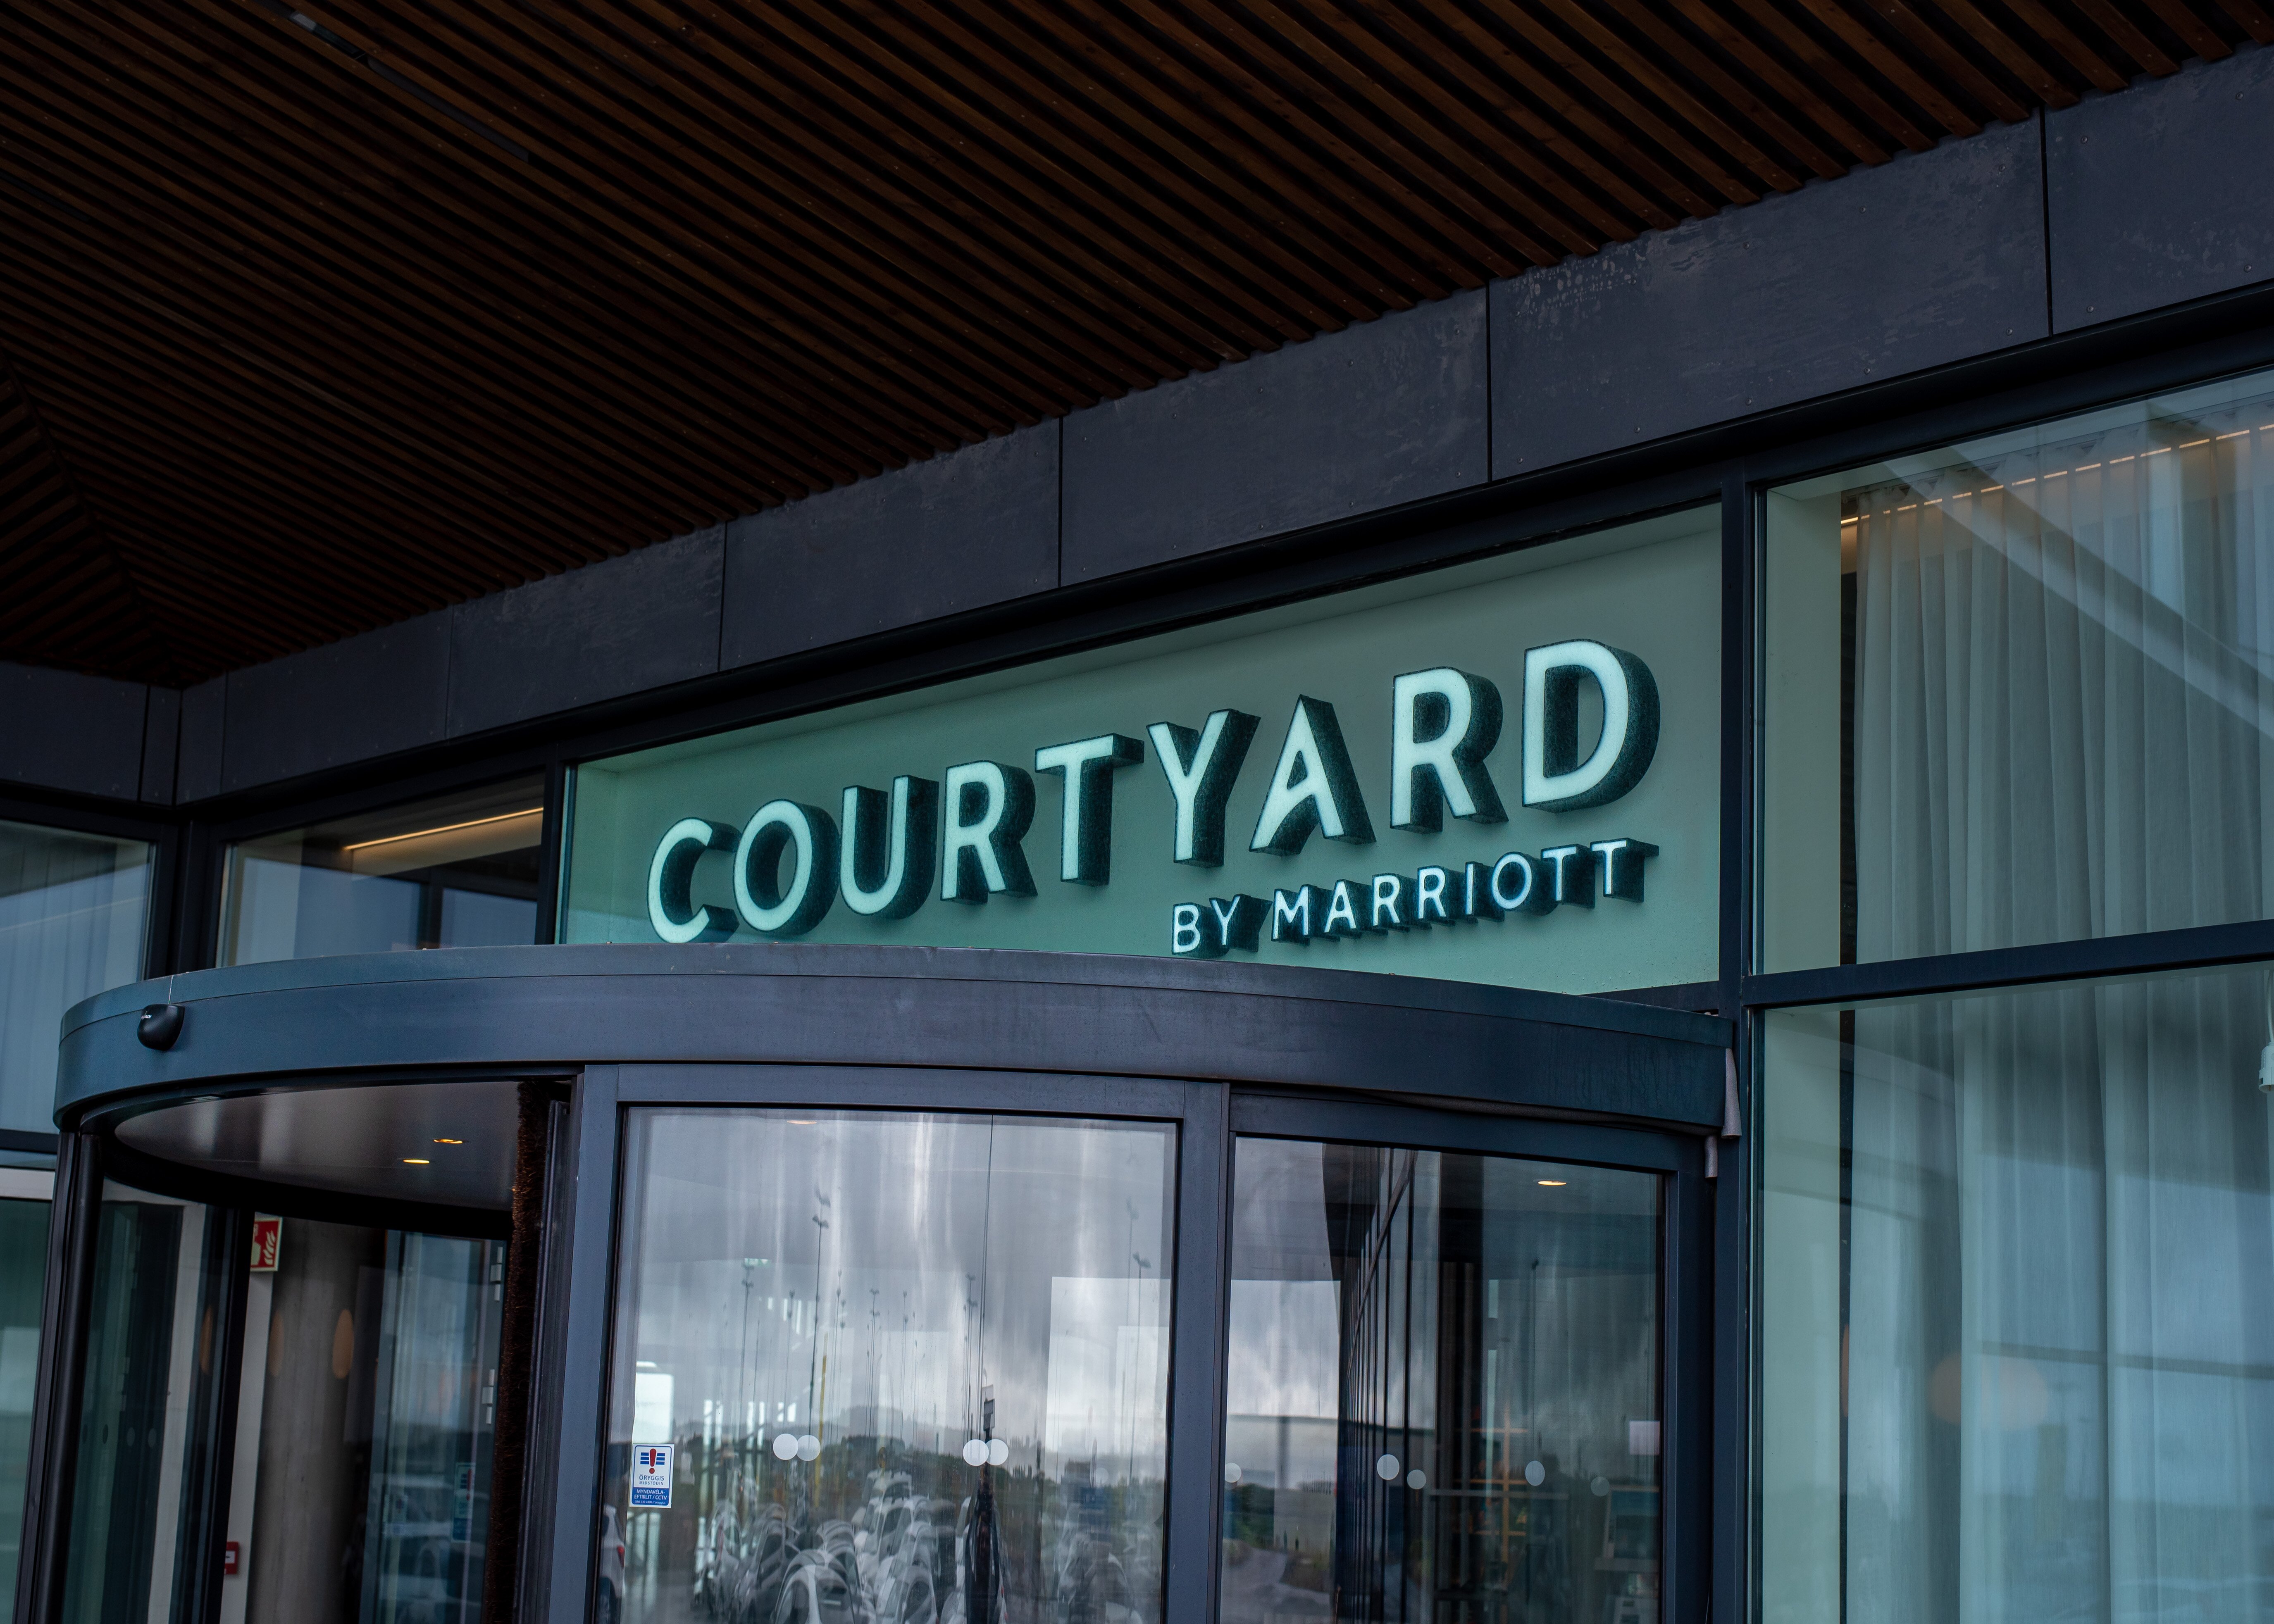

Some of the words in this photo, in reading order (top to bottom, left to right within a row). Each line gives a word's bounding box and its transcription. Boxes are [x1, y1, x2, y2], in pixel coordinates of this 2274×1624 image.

[647, 638, 1645, 943] COURTYARD
[1172, 895, 1248, 955] BY
[1271, 839, 1639, 942] MARRIOTT
